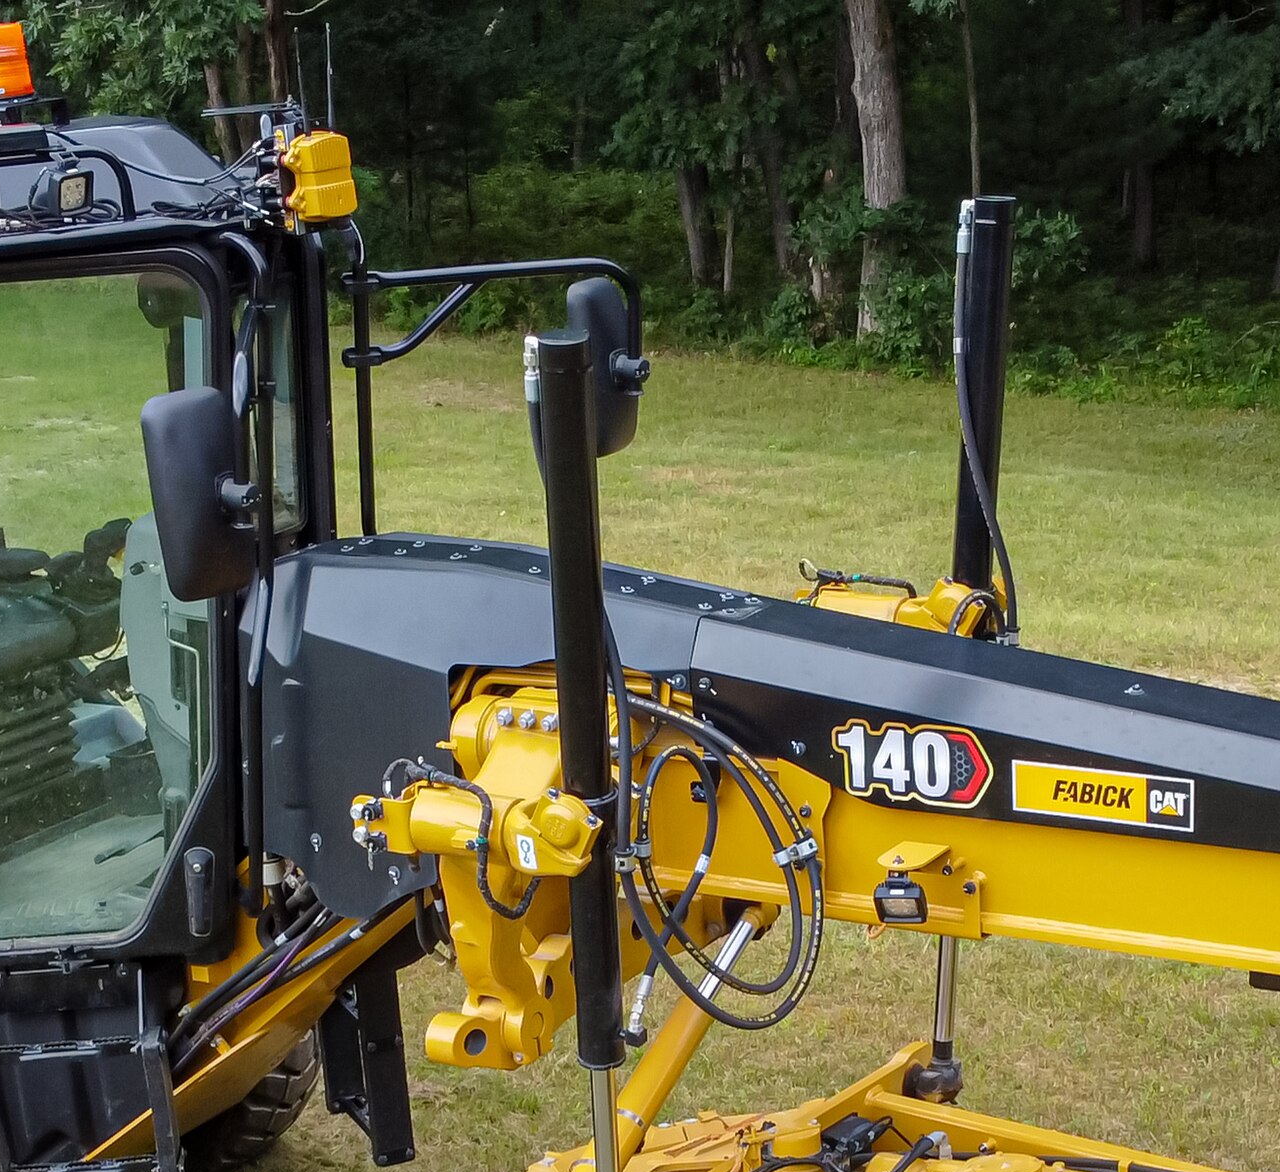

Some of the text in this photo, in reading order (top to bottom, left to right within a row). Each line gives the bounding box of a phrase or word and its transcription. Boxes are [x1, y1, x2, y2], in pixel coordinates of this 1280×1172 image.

[837, 725, 951, 798] 140
[1052, 780, 1189, 817] FABICK CAT
